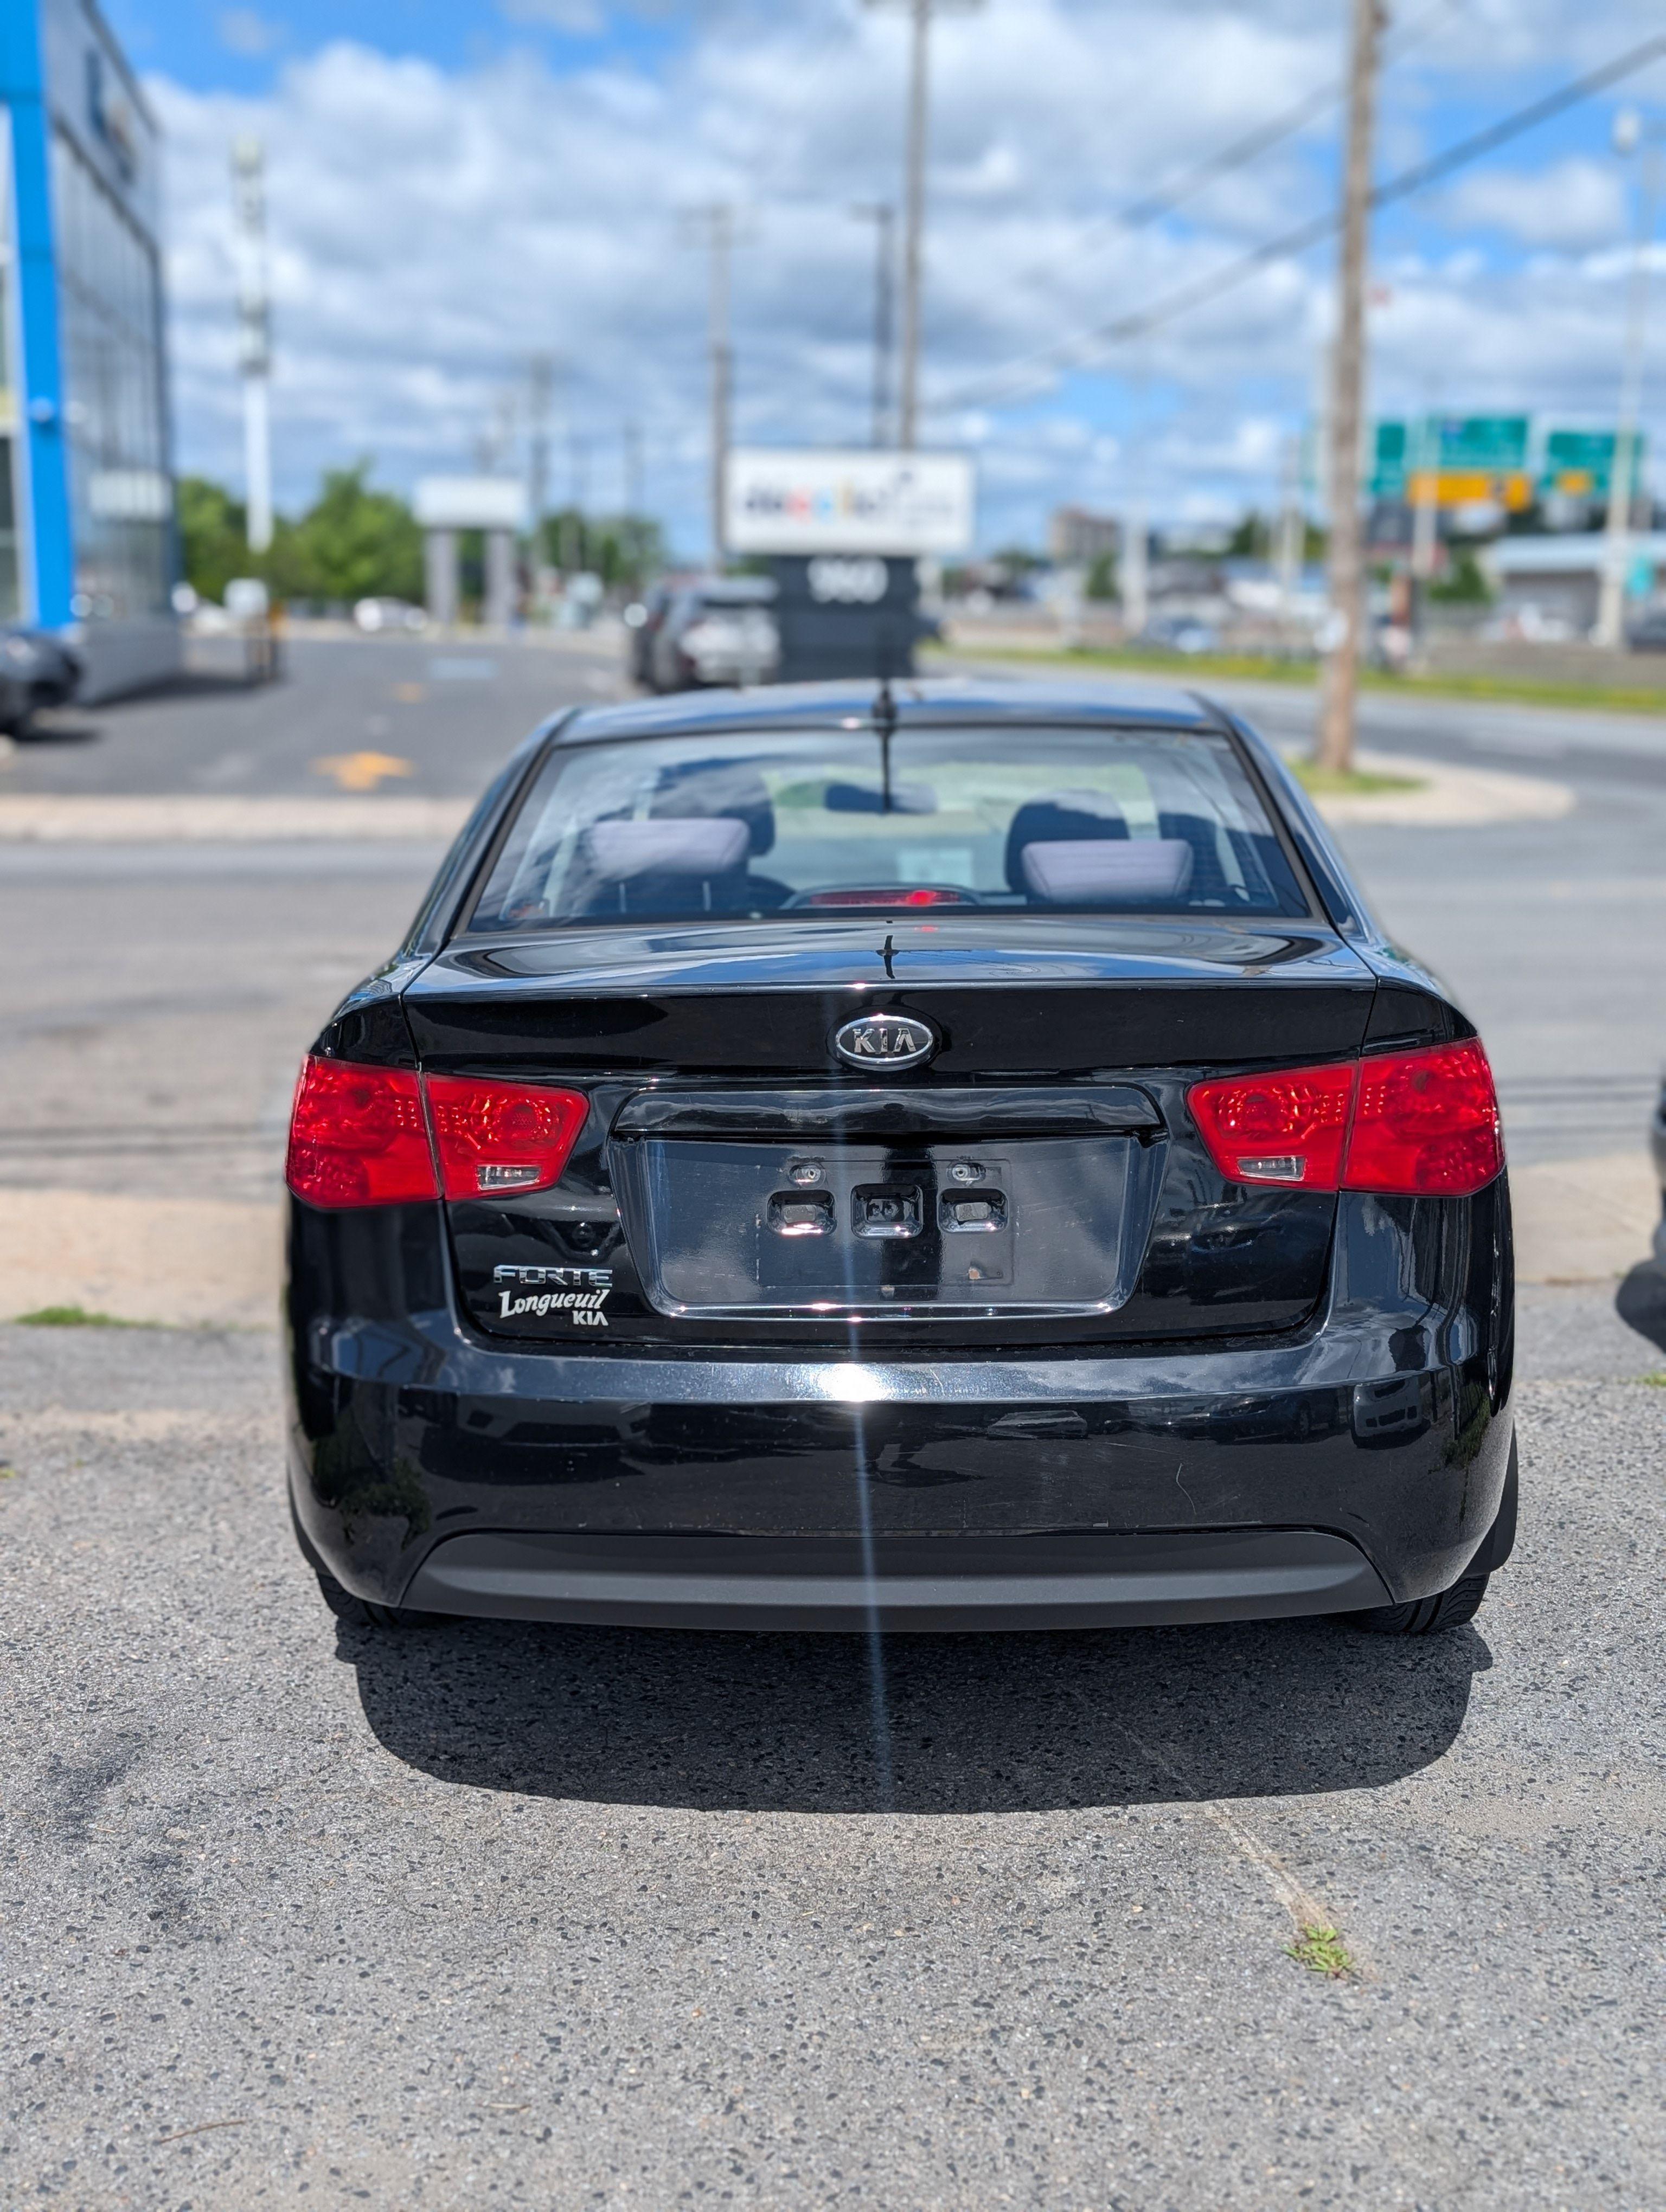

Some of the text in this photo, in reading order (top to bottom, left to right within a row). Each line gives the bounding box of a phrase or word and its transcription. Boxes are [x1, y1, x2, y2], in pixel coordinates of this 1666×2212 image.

[852, 1028, 917, 1053] KIA
[494, 1264, 613, 1287] FORTE
[498, 1289, 610, 1319] Longueuil
[572, 1310, 609, 1326] KIA
